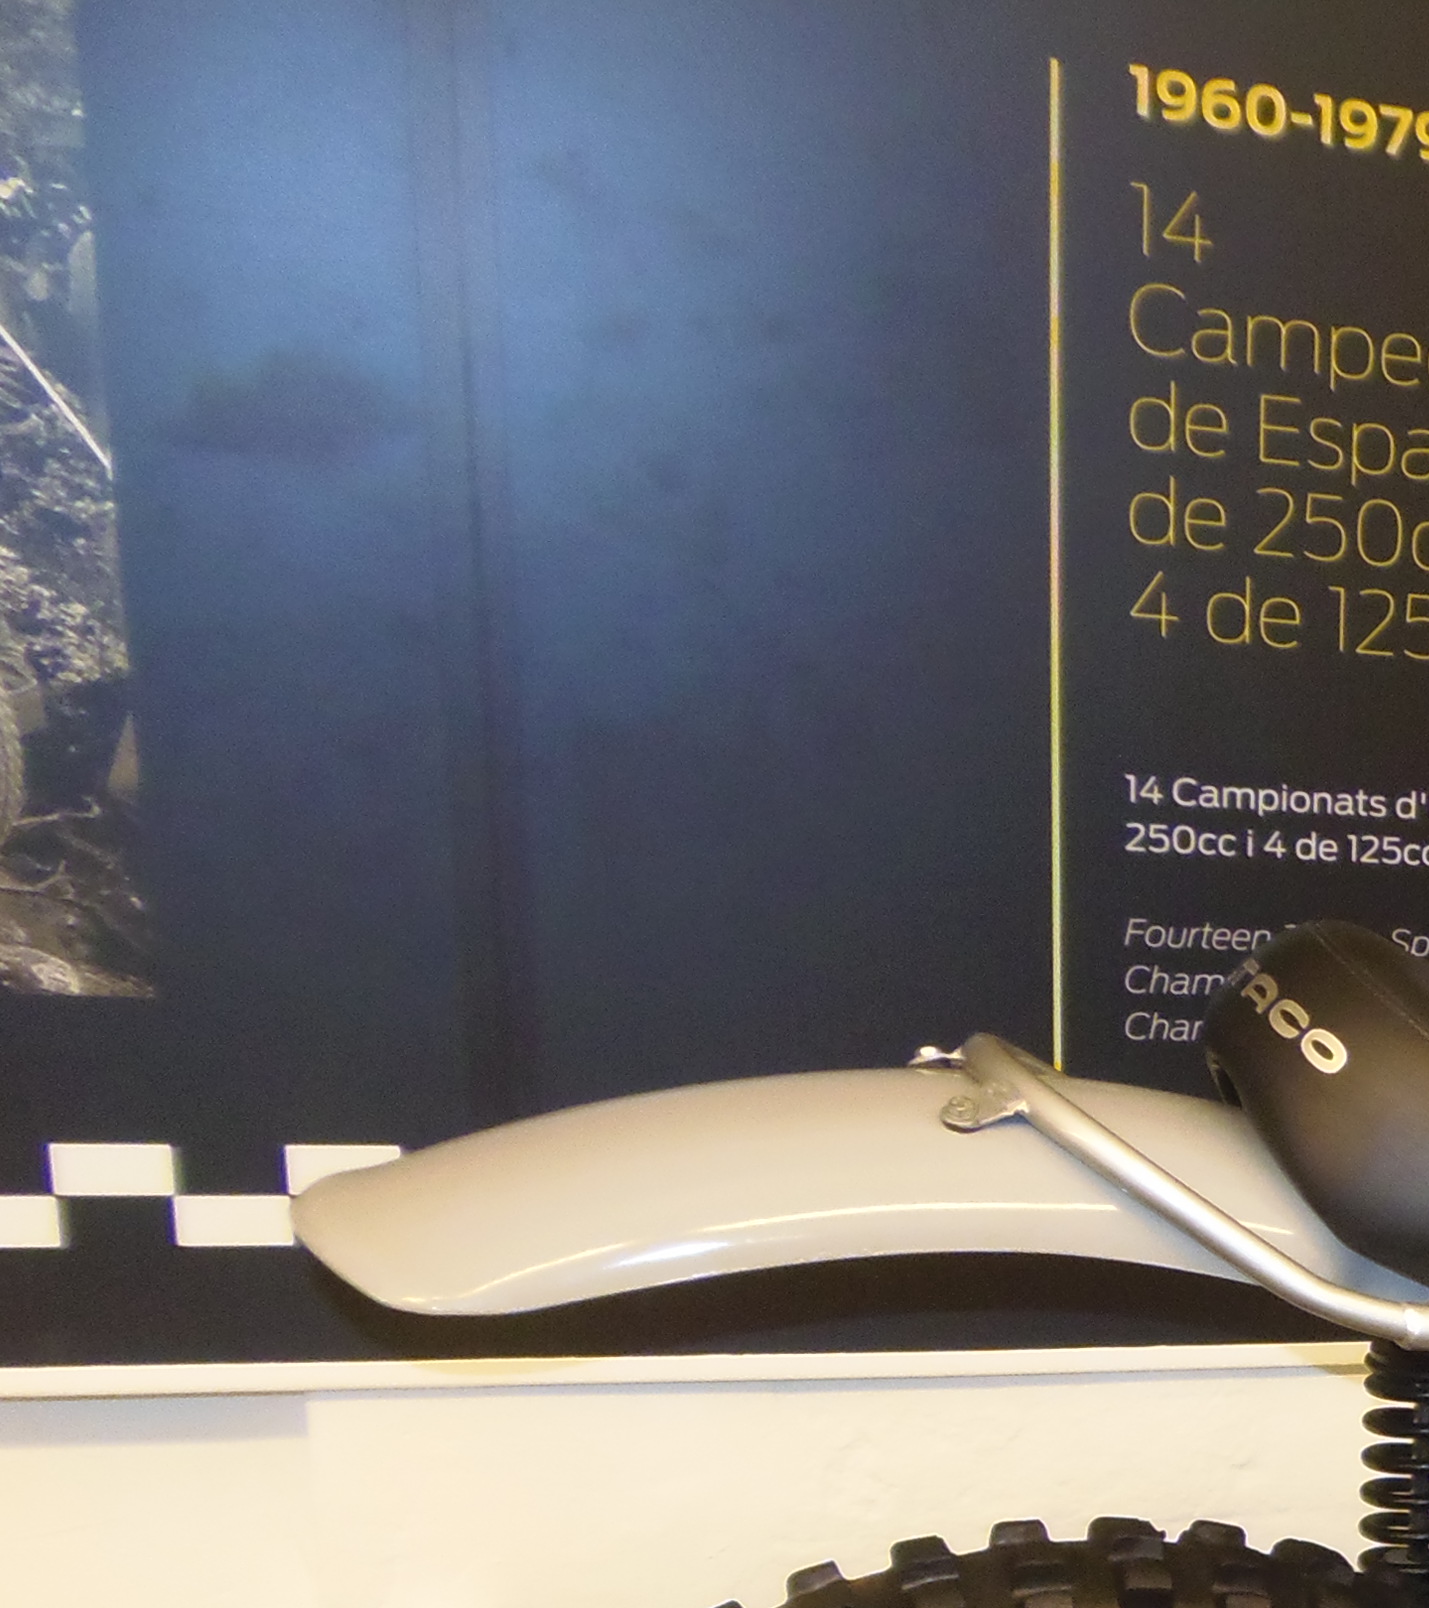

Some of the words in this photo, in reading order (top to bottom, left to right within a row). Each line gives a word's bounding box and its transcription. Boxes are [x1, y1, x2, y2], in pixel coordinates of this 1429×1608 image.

[1130, 181, 1213, 263] 14
[1129, 381, 1230, 458] de
[1129, 475, 1226, 550] de
[1130, 570, 1179, 638] 4
[1206, 575, 1301, 648] de
[1125, 775, 1163, 805] 14
[1171, 776, 1387, 819] Campionats
[1124, 823, 1236, 857] 250cc
[1245, 829, 1254, 857] i
[1263, 831, 1287, 859] 4
[1295, 832, 1338, 862] de
